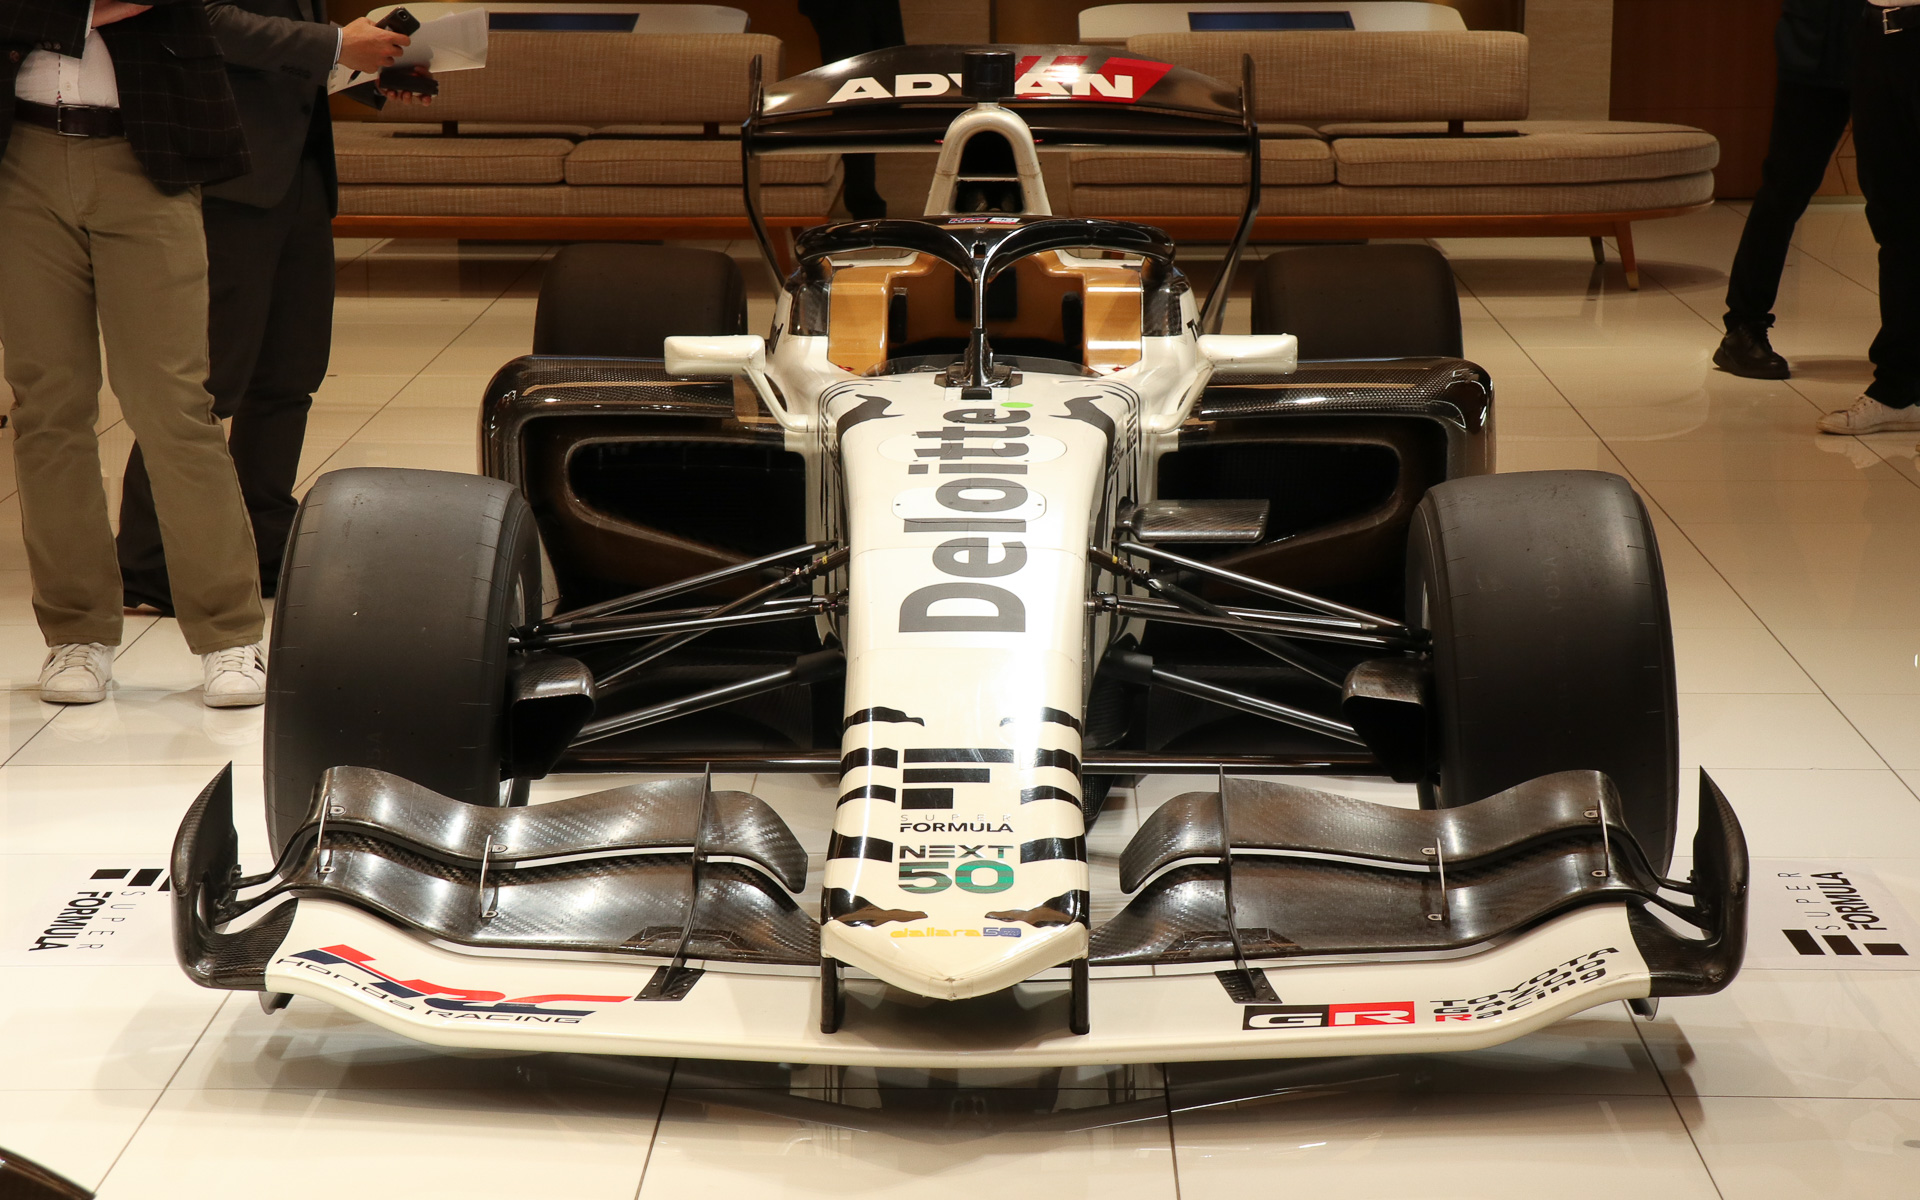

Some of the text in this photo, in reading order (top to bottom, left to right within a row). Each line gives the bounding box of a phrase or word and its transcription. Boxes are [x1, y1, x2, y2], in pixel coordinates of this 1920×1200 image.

[899, 845, 1014, 859] NEXT
[900, 823, 1014, 832] FORMULA
[898, 860, 1014, 894] 50
[1777, 872, 1841, 930] SUPER
[1810, 871, 1888, 930] FORMULA
[28, 891, 113, 951] FORMULA
[76, 890, 146, 949] SUPER
[1430, 947, 1619, 1006] TOYOTA
[1434, 958, 1606, 1014] GAZOO
[1435, 967, 1606, 1022] Racing
[425, 1009, 582, 1024] RACING
[1247, 1007, 1411, 1029] GR
